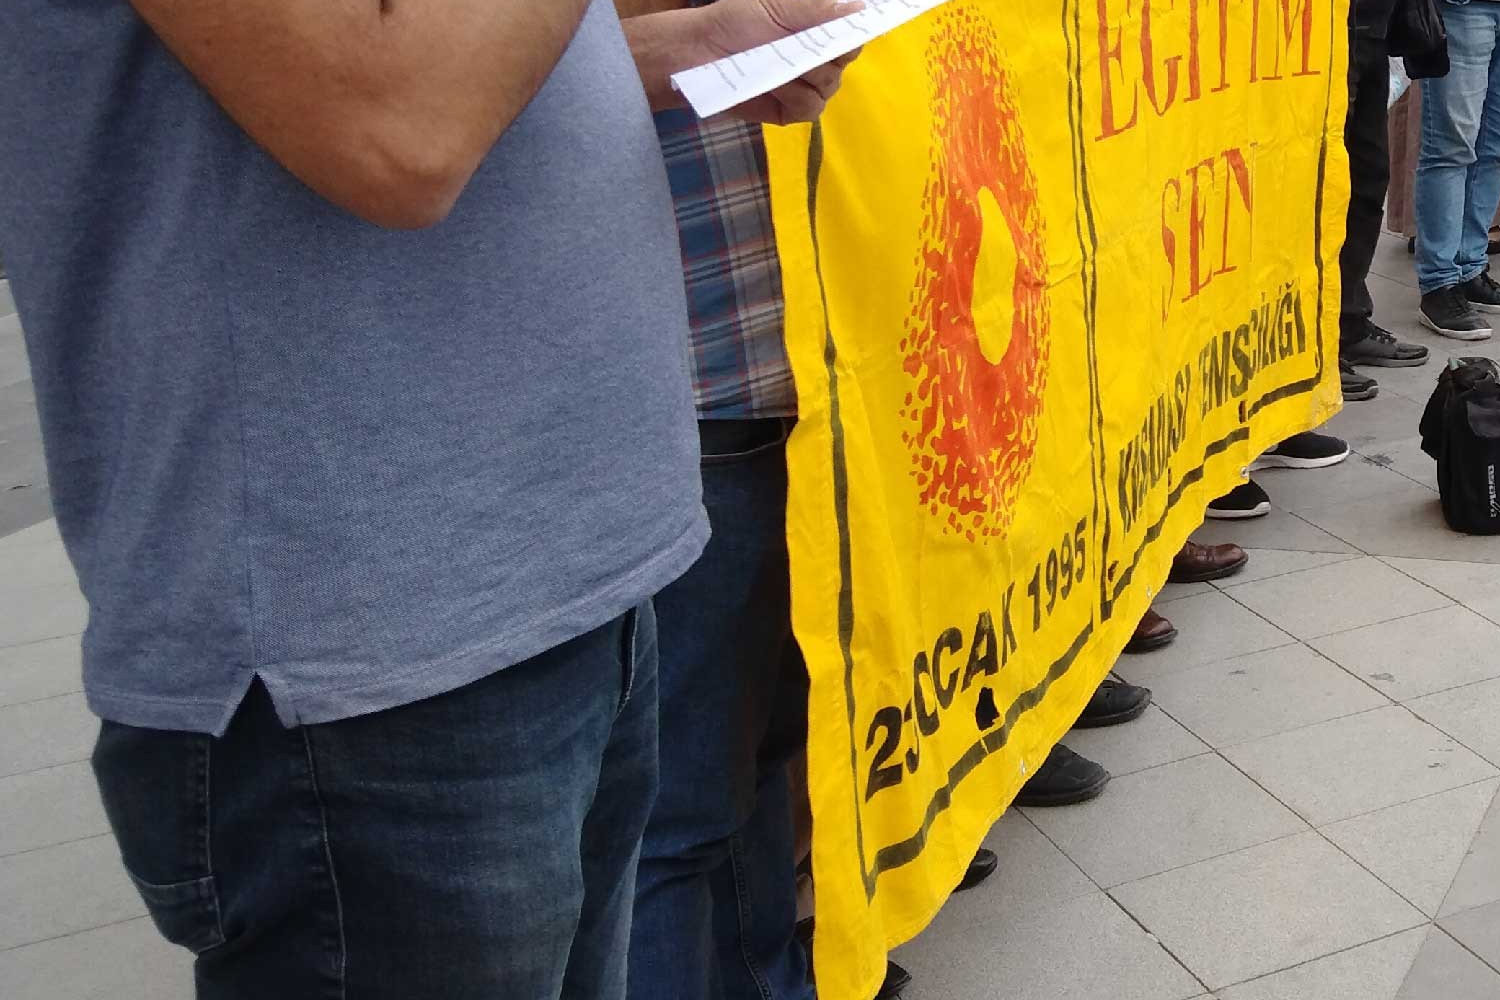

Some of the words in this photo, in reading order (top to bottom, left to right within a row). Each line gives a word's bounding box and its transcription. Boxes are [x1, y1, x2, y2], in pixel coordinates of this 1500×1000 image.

[1162, 141, 1259, 328] SEN
[913, 582, 1017, 737] OCAK
[1027, 516, 1087, 633] 1995
